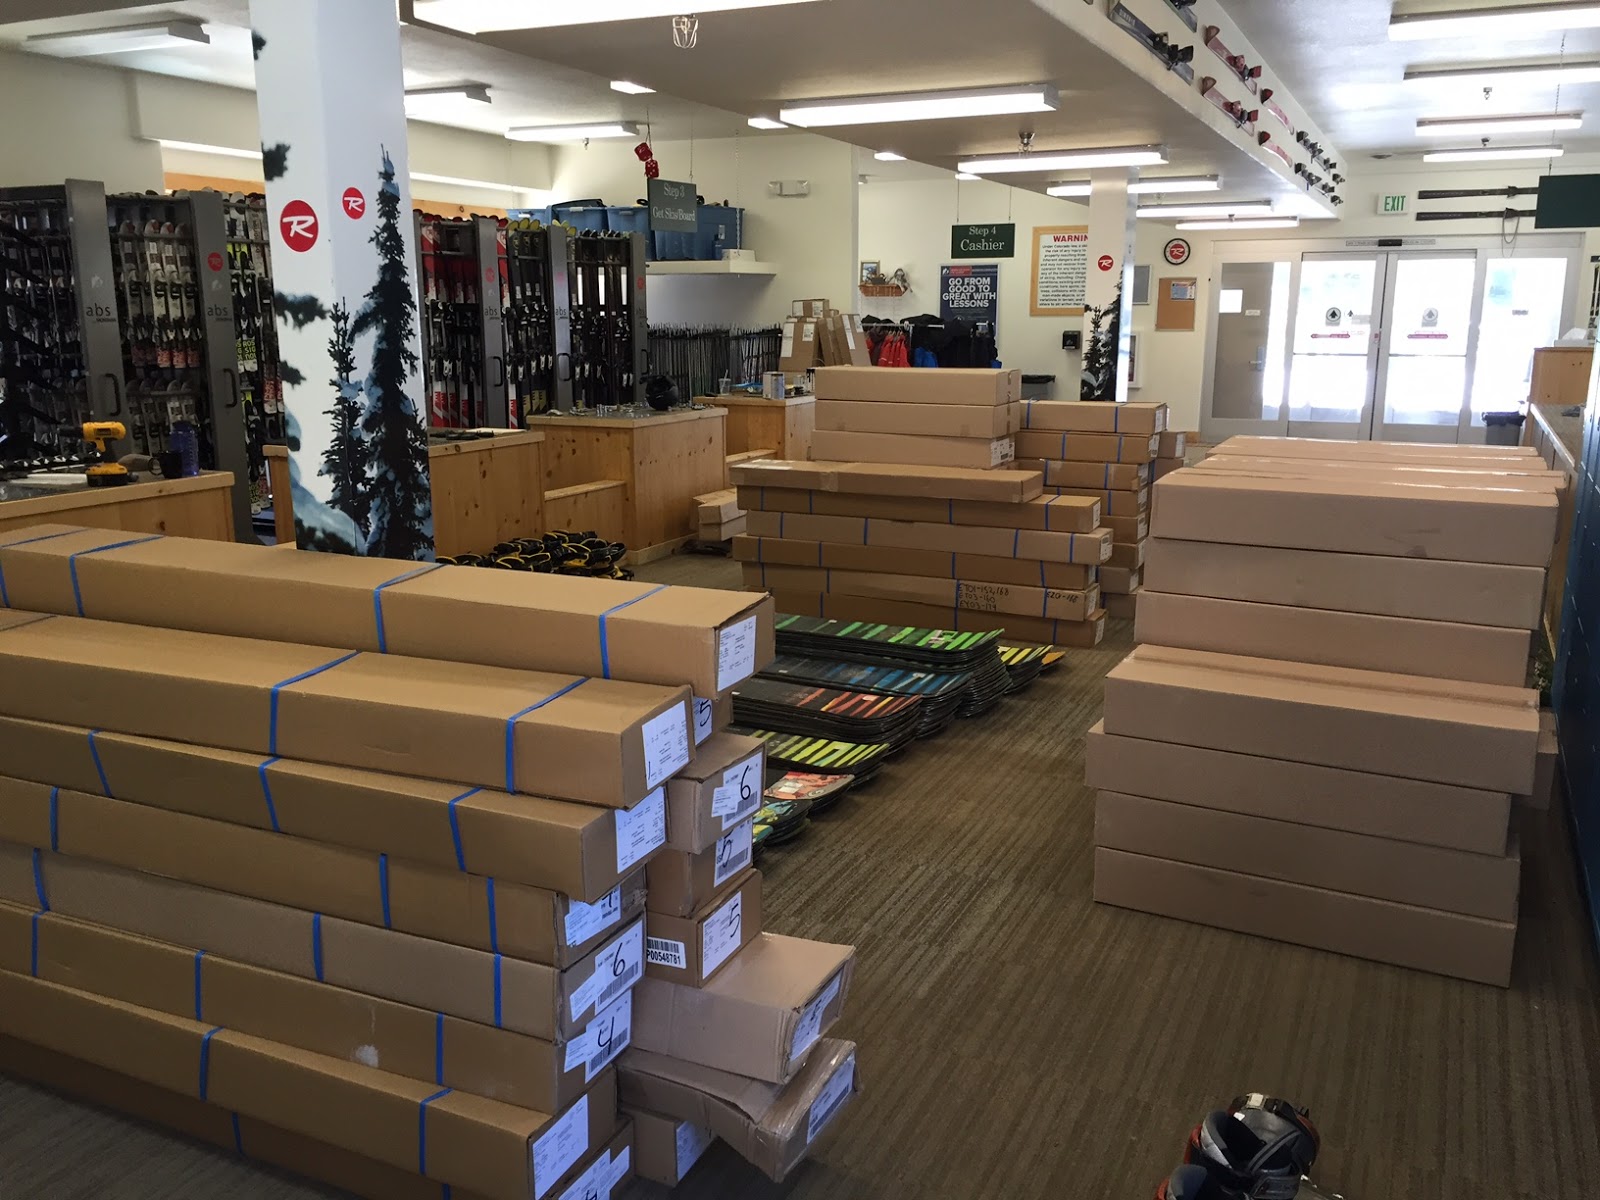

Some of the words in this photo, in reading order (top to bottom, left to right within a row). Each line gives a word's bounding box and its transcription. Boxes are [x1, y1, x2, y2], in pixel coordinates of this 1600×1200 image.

[664, 182, 680, 199] Step
[680, 185, 685, 198] 3
[1384, 195, 1406, 211] EXIT
[652, 206, 664, 219] Get
[282, 215, 315, 238] R
[969, 225, 989, 237] Step
[990, 225, 996, 235] 4
[960, 238, 1005, 251] Cashier
[1053, 234, 1088, 242] WARNIN
[964, 277, 991, 285] FROM
[948, 285, 976, 293] GOOD
[978, 284, 990, 292] TO
[942, 292, 971, 300] GREAT
[973, 292, 996, 300] WITH
[86, 303, 111, 317] abs
[207, 304, 228, 317] abs
[484, 307, 498, 316] abs
[555, 307, 567, 316] abs
[700, 699, 712, 727] 5
[740, 765, 751, 800] 6
[728, 903, 740, 938] 5
[613, 942, 626, 977] 6
[597, 1016, 615, 1056] 4
